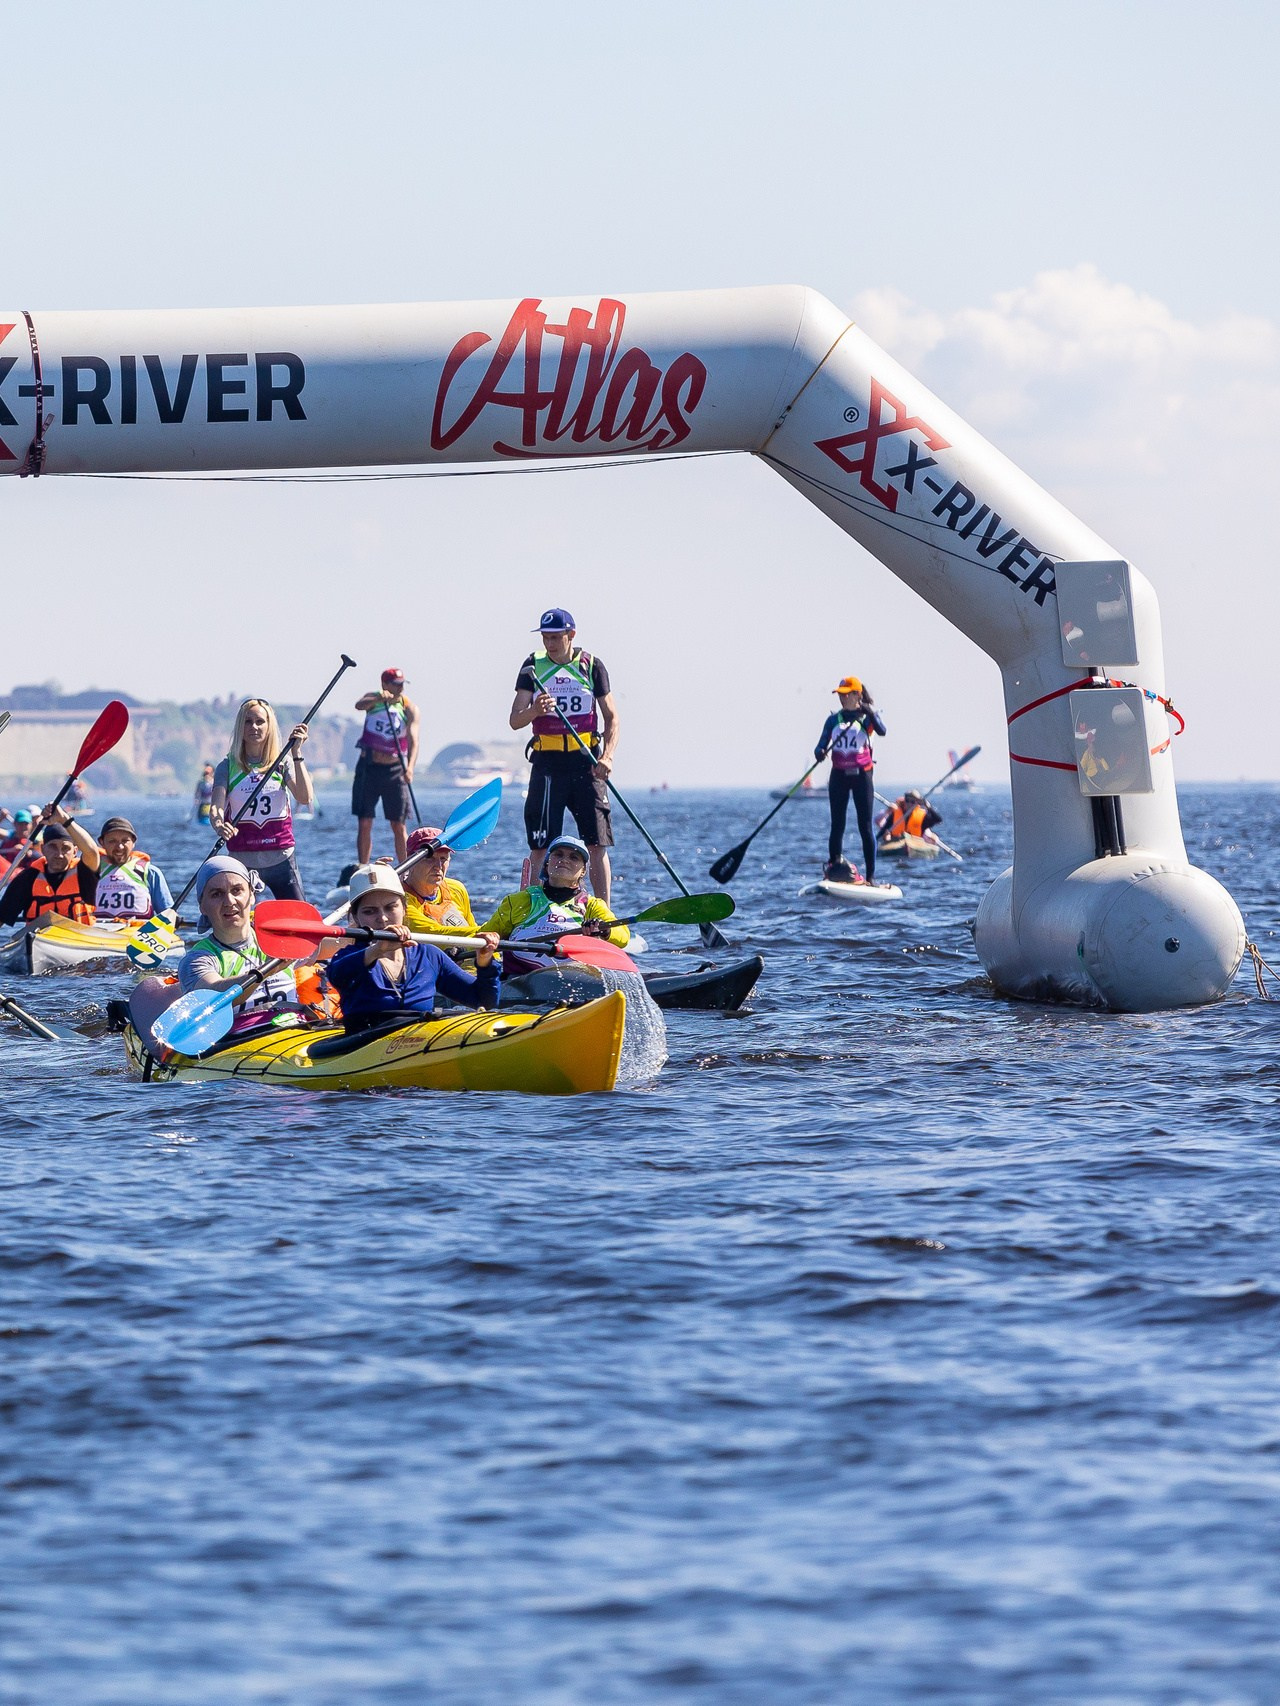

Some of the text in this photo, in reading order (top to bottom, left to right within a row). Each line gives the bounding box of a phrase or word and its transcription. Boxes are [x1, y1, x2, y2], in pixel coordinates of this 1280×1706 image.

[430, 298, 707, 457] Atlas
[883, 438, 1057, 608] X-RIVER
[98, 892, 135, 909] 430
[137, 932, 166, 953] PRO
